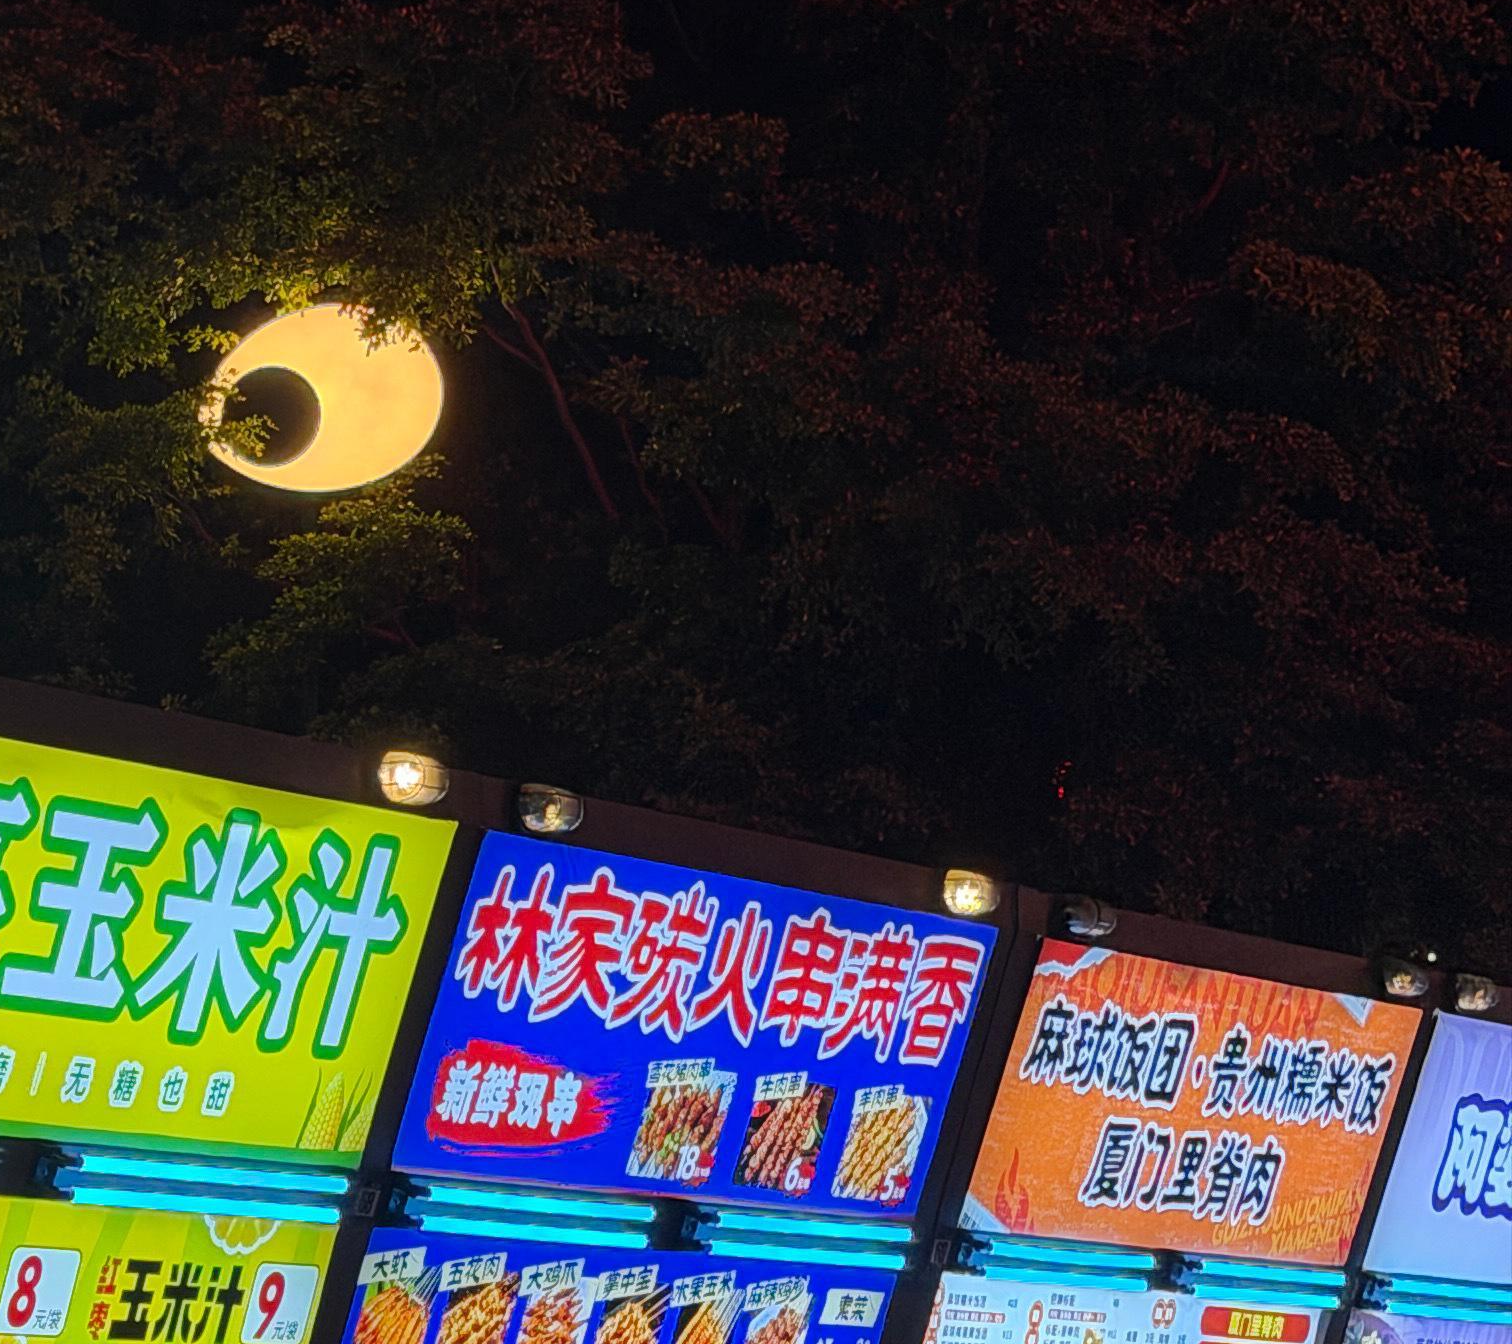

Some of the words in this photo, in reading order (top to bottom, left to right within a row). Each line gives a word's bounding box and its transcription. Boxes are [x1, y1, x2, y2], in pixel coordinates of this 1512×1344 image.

[759, 1074, 804, 1097] 牛肉串
[858, 1086, 899, 1107] 羊肉串
[1080, 1116, 1285, 1226] 厦门里脊肉
[446, 1255, 502, 1286] 五花肉
[107, 1259, 245, 1344] 玉米汁
